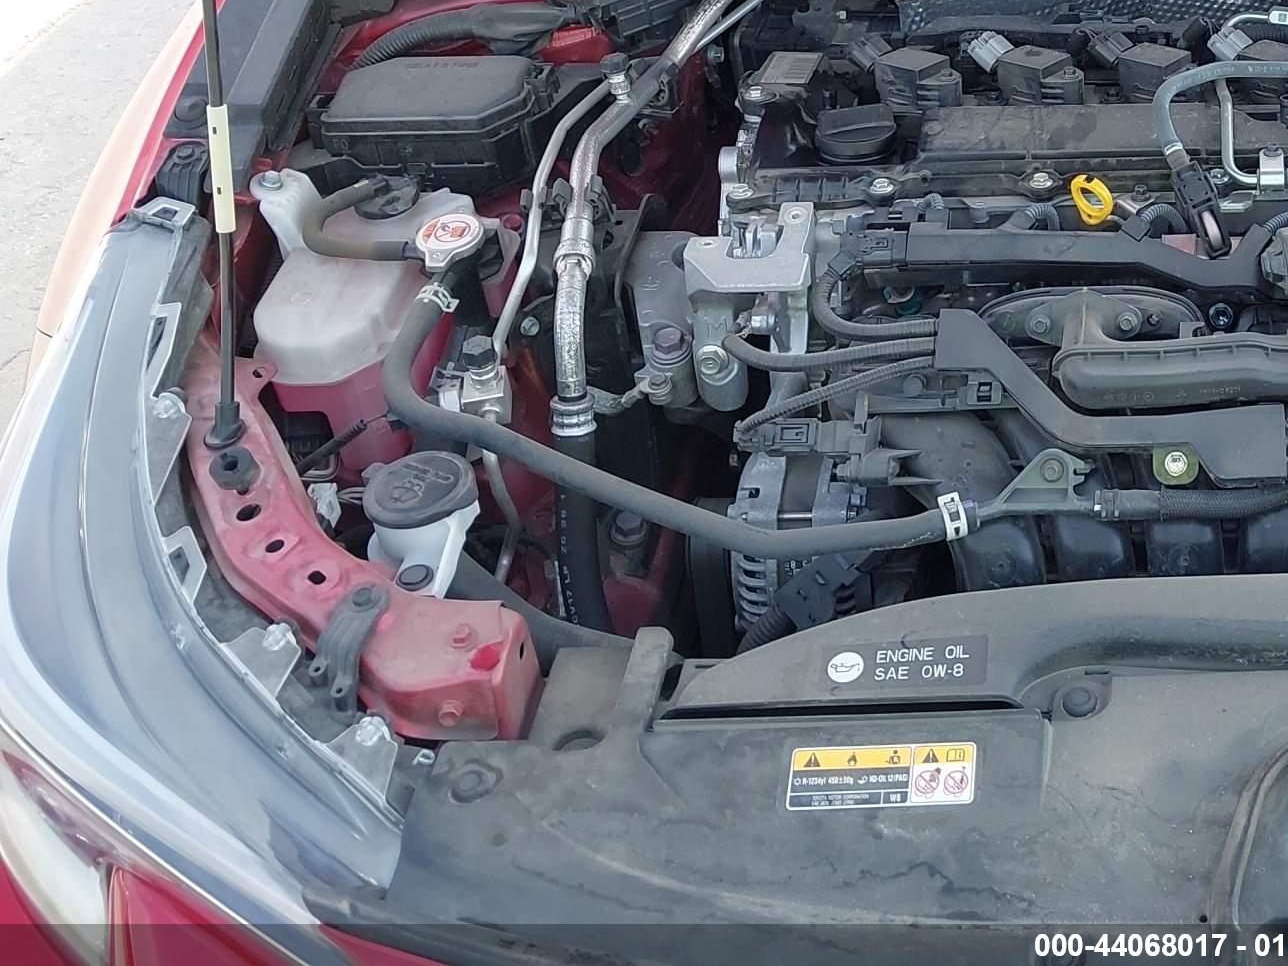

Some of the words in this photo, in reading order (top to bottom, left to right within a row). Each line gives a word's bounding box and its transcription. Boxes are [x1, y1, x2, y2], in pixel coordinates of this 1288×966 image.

[876, 647, 935, 663] ENGINE
[945, 645, 970, 659] OIL
[874, 666, 910, 681] SAE
